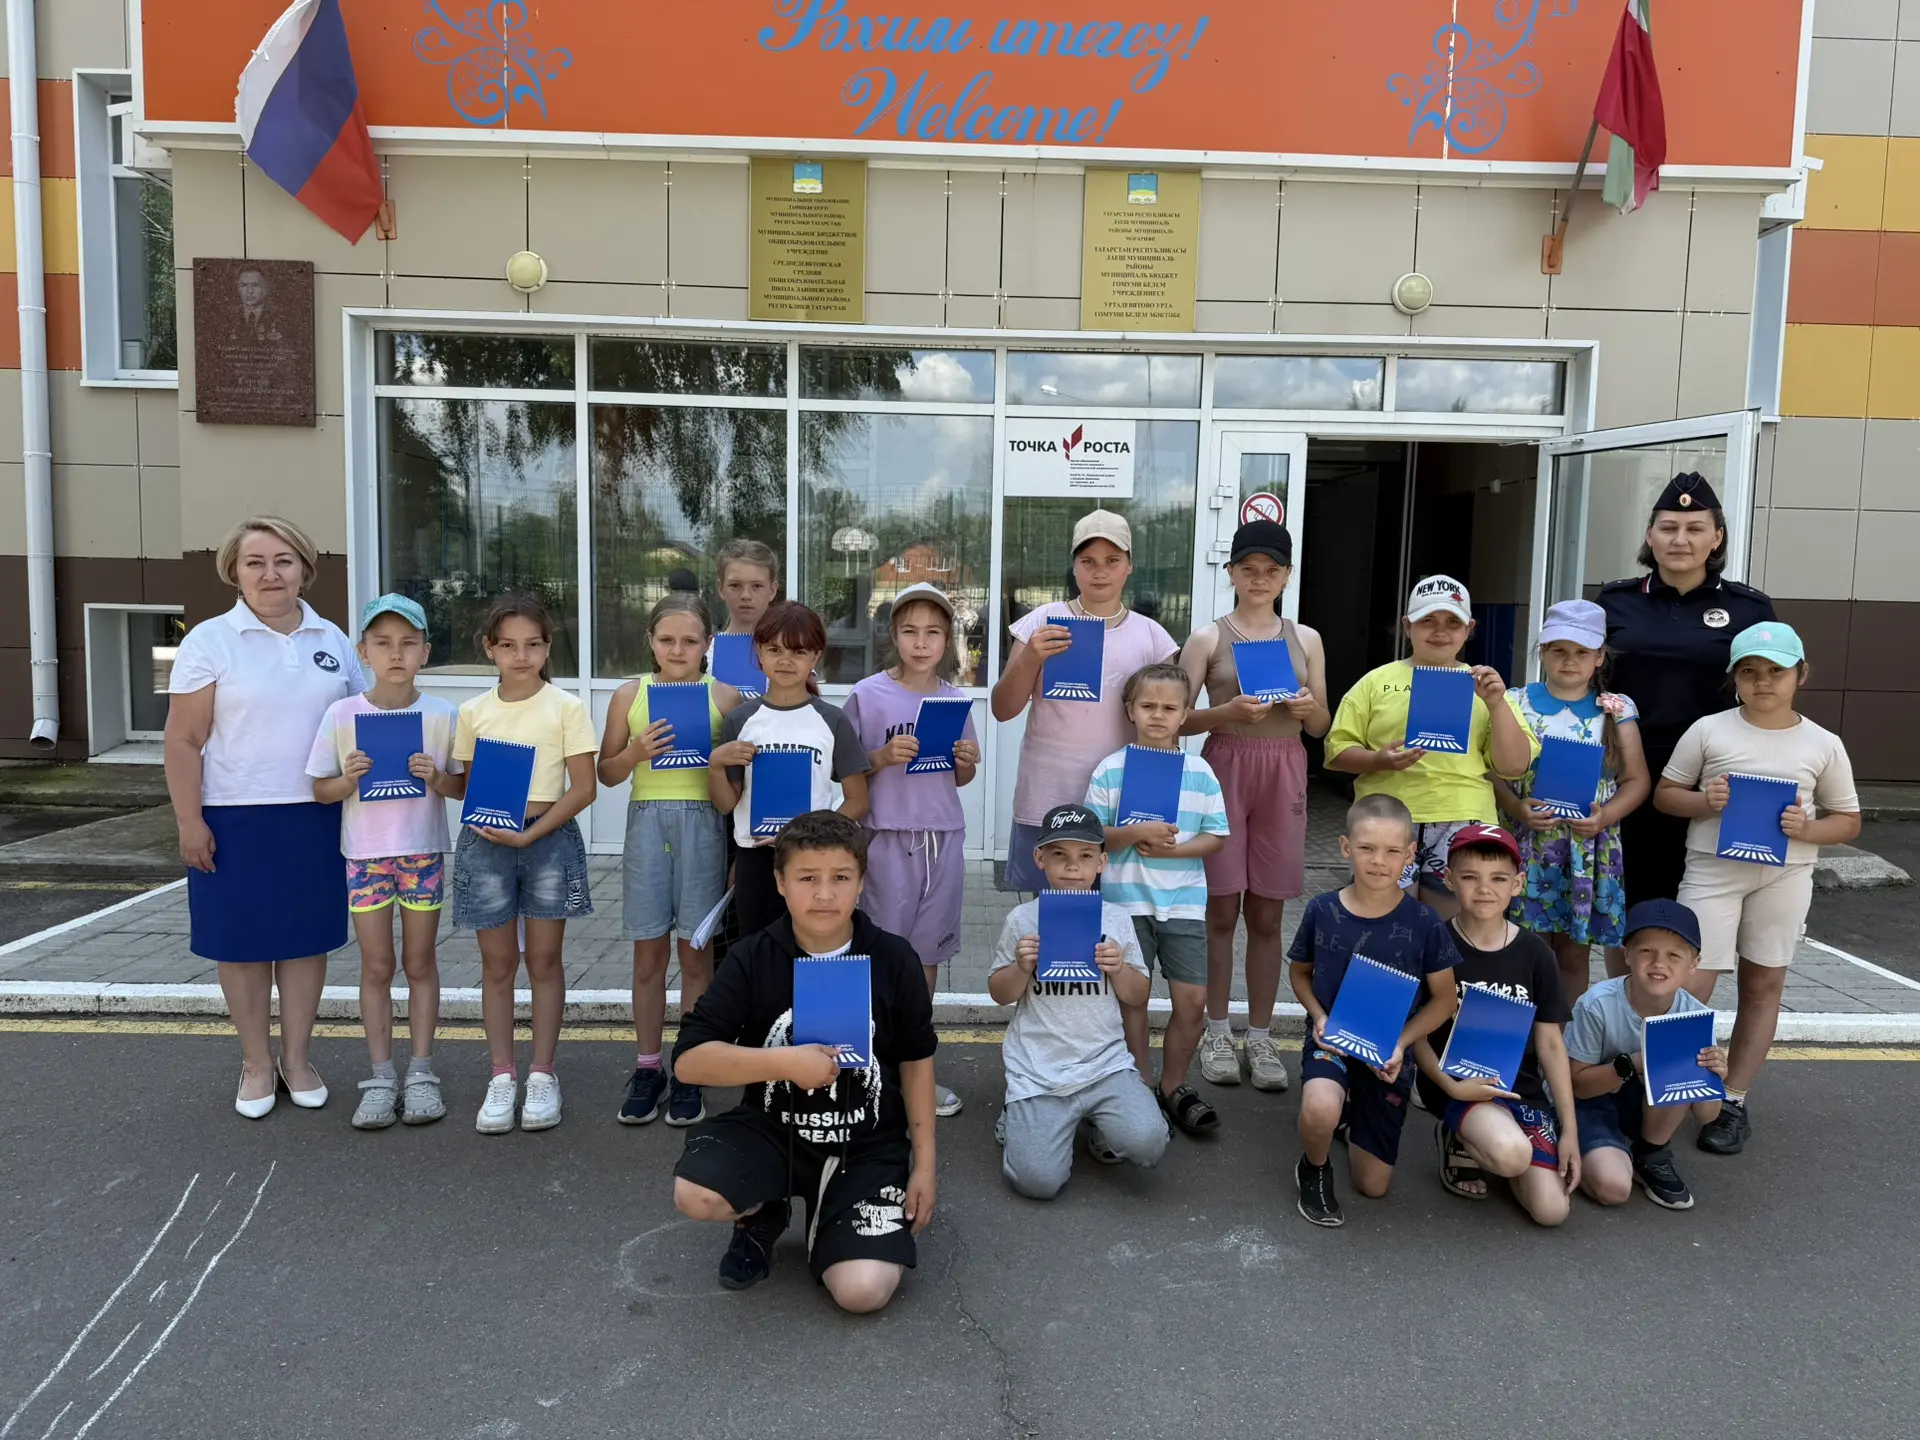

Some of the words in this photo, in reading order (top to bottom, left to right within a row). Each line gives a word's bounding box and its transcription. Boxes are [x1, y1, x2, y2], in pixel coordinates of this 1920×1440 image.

[841, 66, 1124, 143] Welcome!
[1009, 440, 1058, 452] ТОЧКА
[1084, 442, 1130, 453] РОСТА
[1416, 581, 1435, 596] NEW
[1436, 580, 1461, 595] YORK
[781, 1107, 865, 1127] RUSSIAN
[798, 1130, 851, 1144] BEAR
